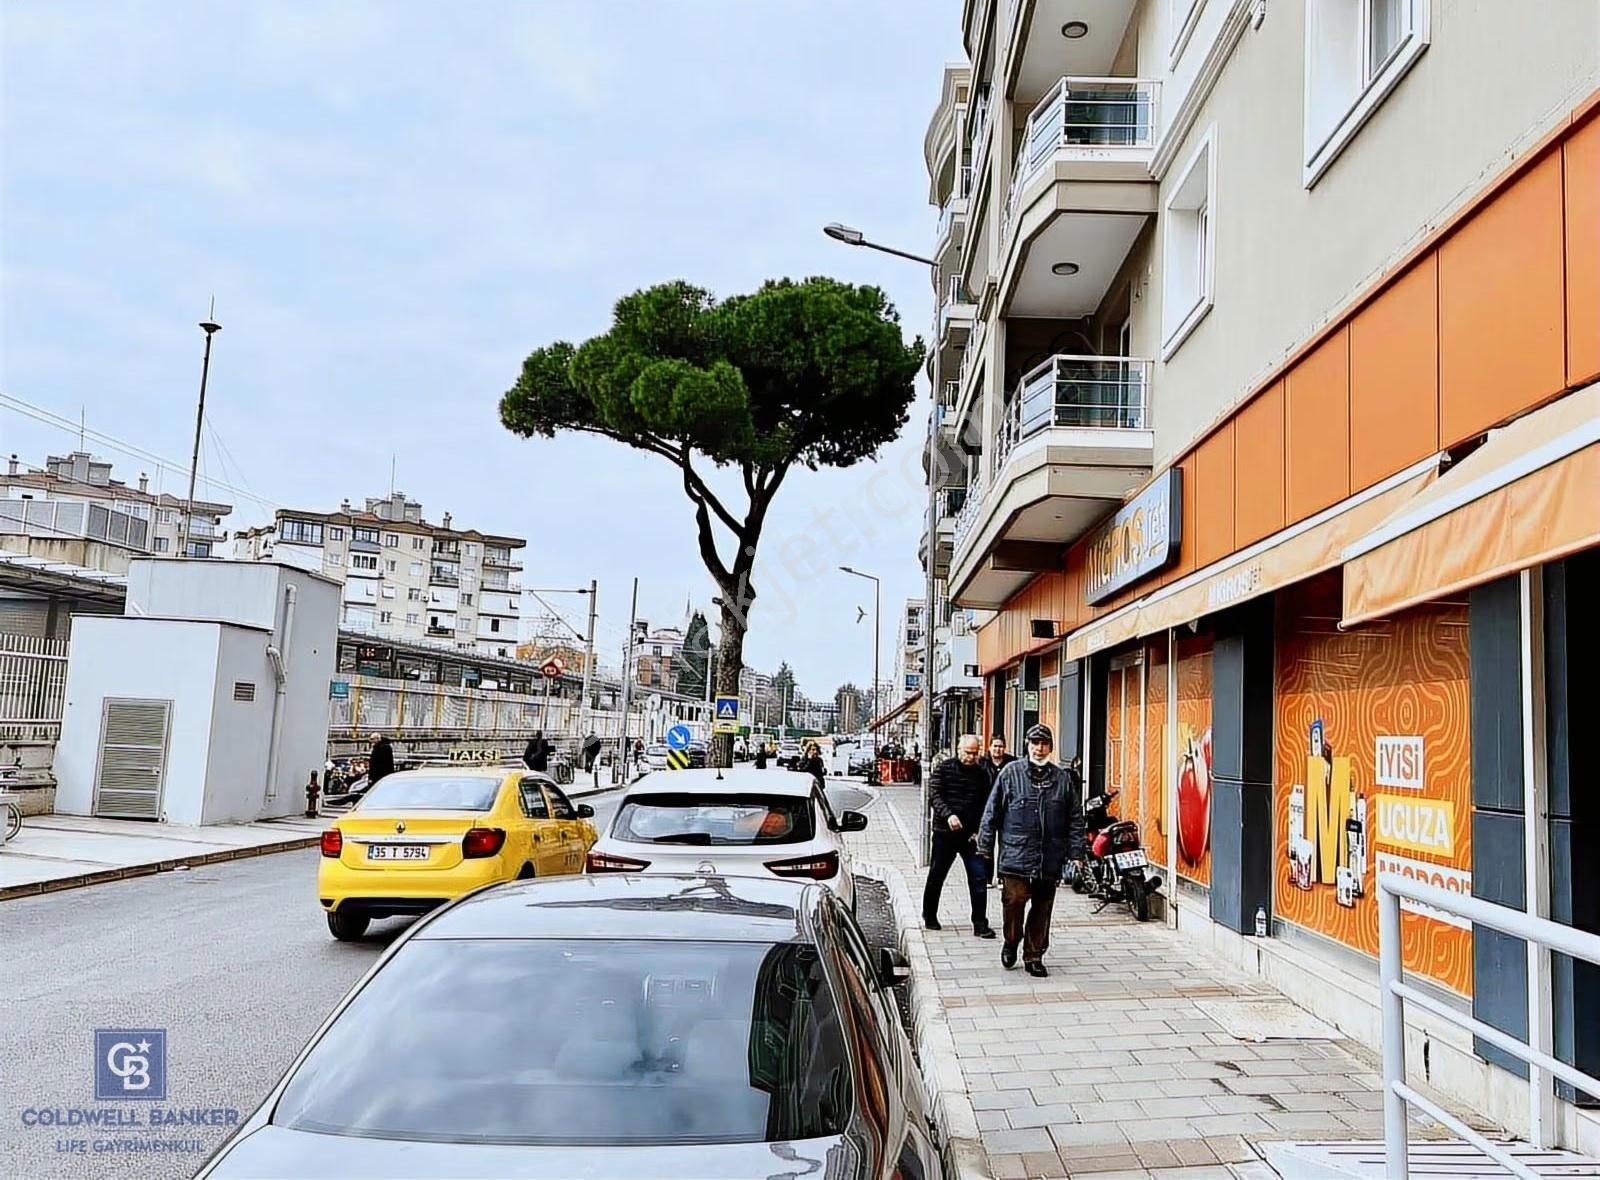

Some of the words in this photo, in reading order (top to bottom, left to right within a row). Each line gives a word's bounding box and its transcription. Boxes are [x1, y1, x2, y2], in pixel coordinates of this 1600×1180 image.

[1379, 800, 1451, 850] UCUZA
[375, 847, 386, 858] 35
[403, 847, 427, 858] 5794
